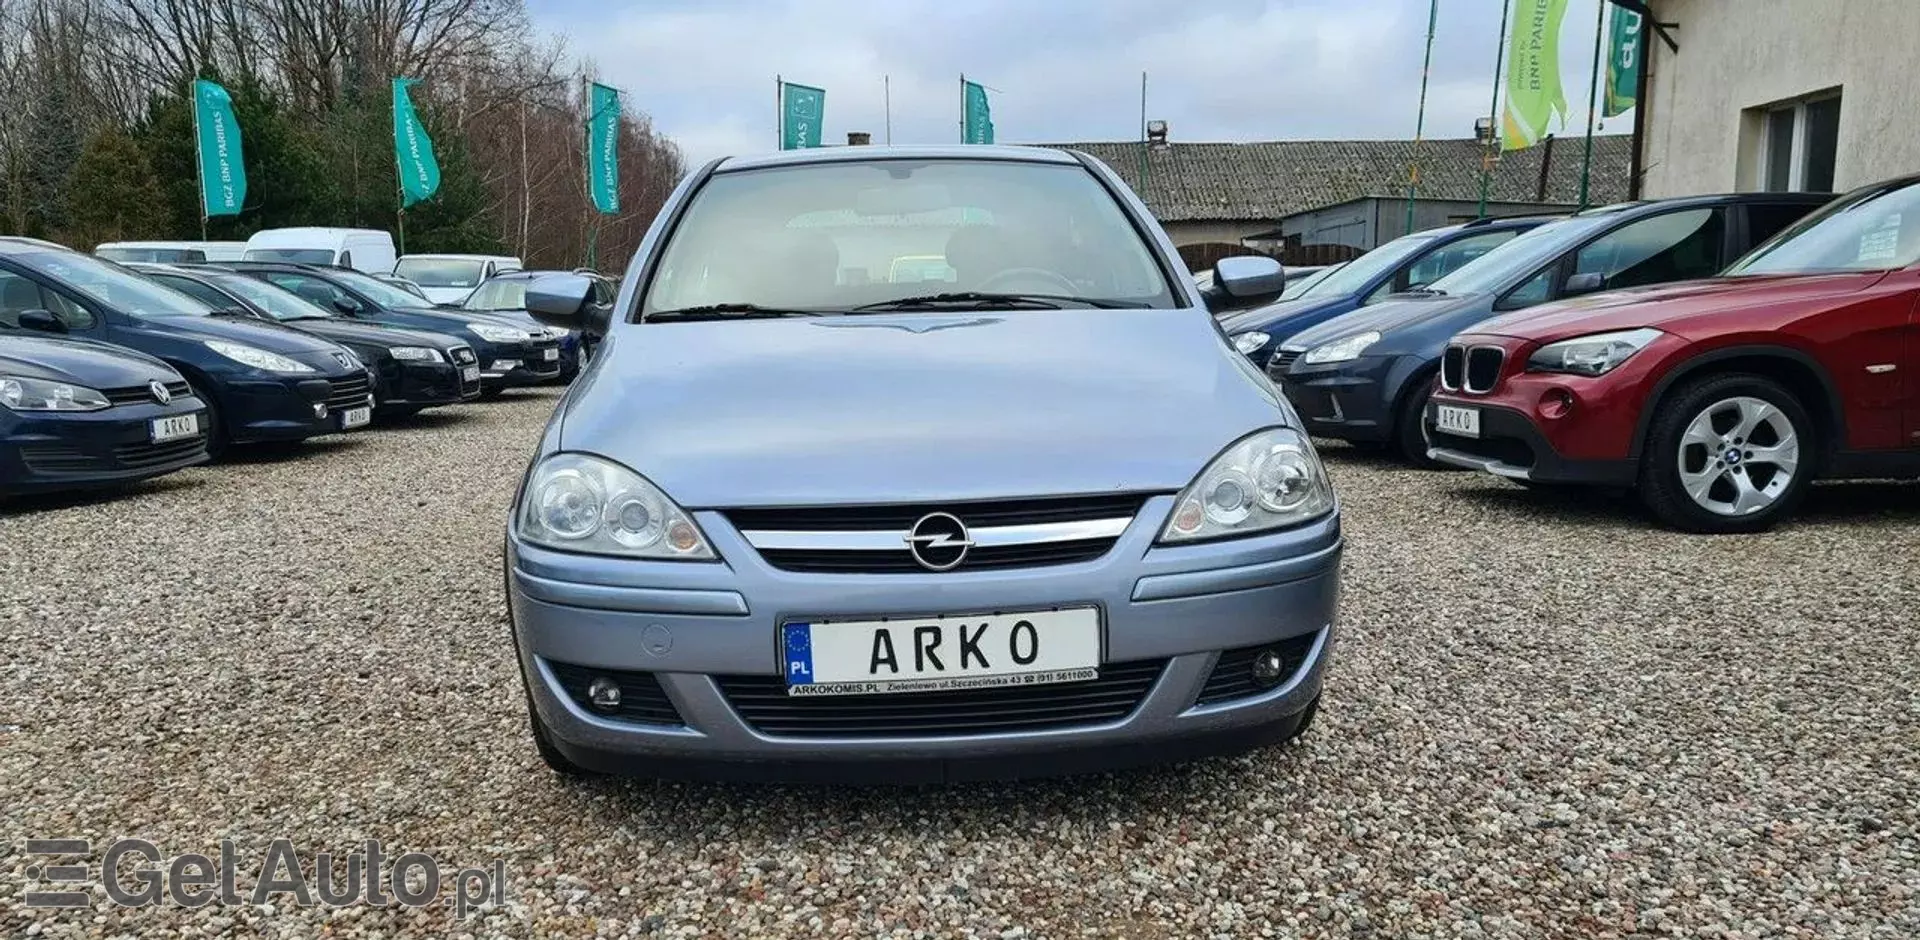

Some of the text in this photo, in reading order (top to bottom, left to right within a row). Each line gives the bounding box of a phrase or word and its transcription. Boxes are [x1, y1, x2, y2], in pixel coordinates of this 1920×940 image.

[1529, 54, 1541, 91] BNP
[213, 111, 228, 158] PARIBAS
[164, 417, 190, 436] ARKO
[1442, 409, 1470, 430] ARKO
[870, 620, 1039, 674] ARKO
[791, 661, 809, 675] PL
[793, 684, 880, 695] ARKOKOMIS.PL
[887, 681, 937, 692] Zieleniewo
[1010, 676, 1021, 684] 43
[1056, 670, 1093, 681] 5611000
